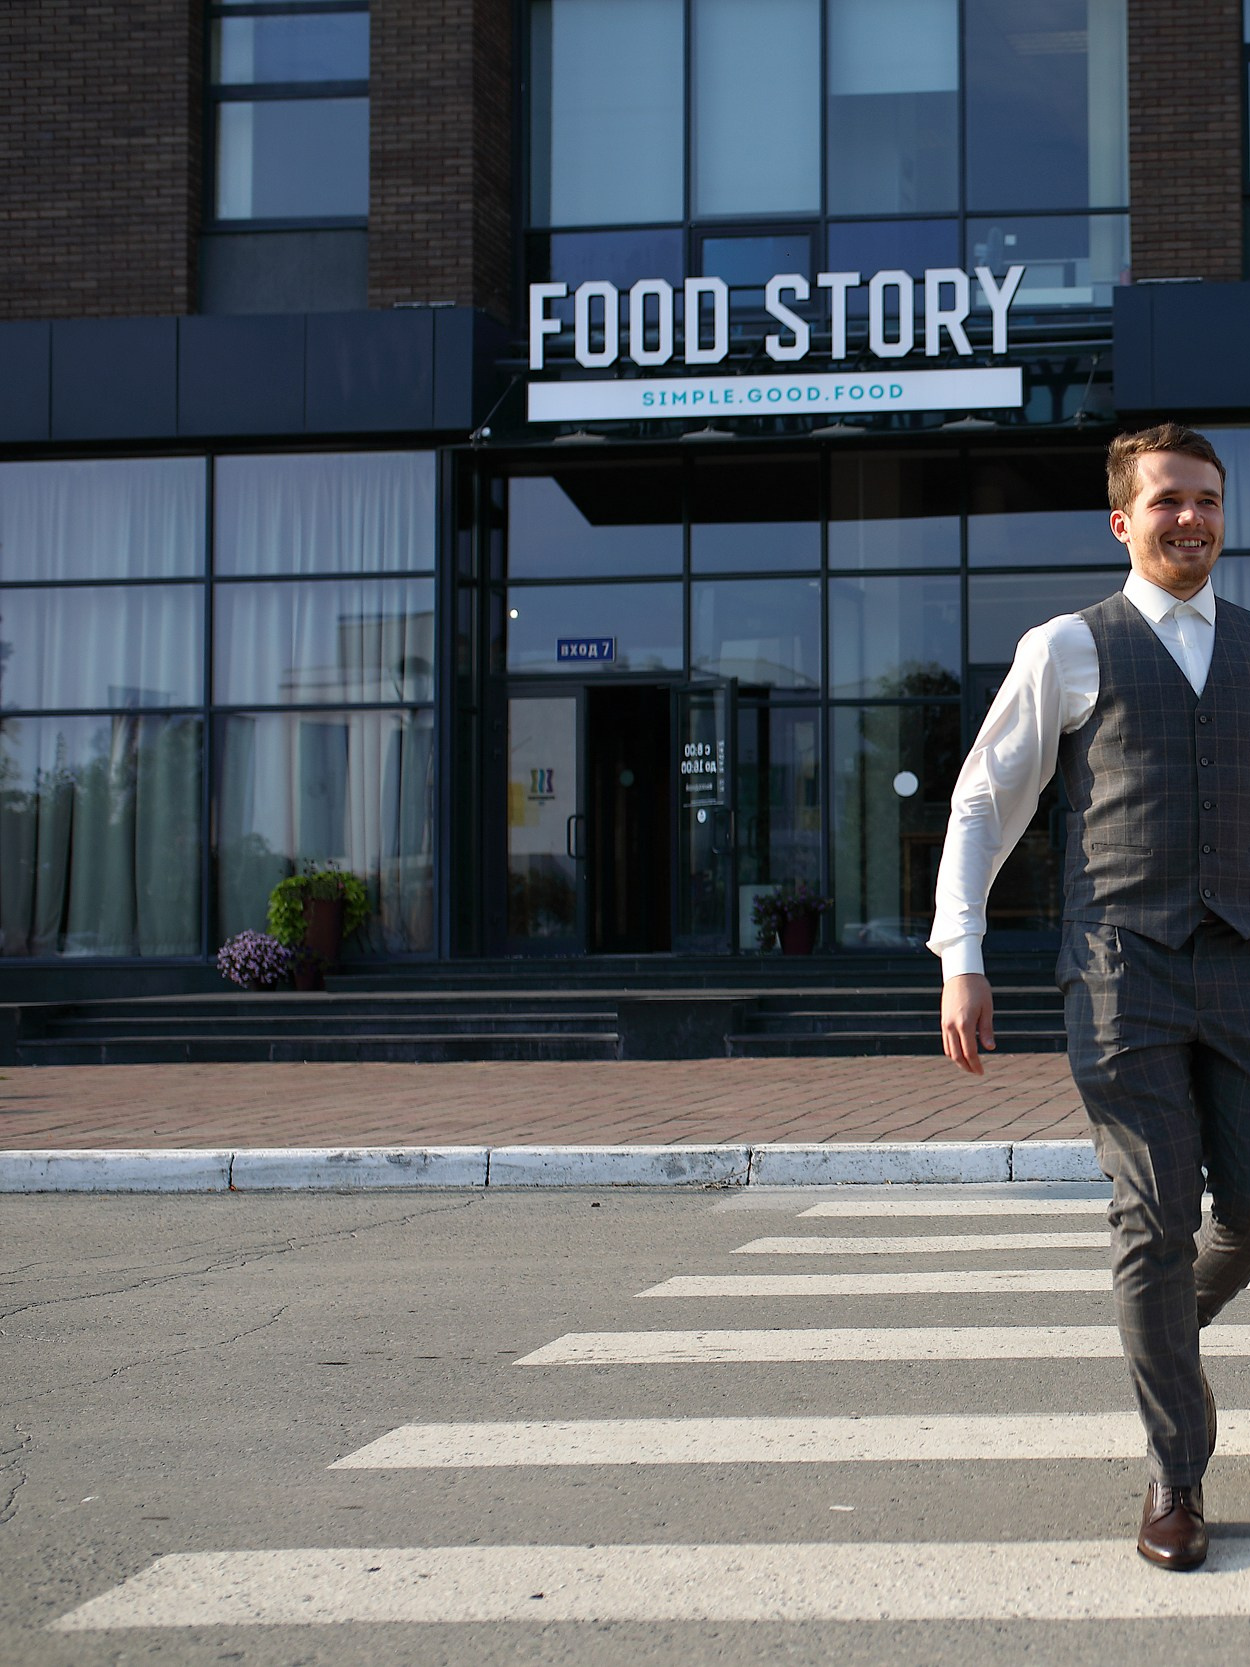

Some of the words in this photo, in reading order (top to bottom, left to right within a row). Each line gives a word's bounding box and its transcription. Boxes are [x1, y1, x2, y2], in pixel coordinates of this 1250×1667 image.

[529, 276, 729, 370] FOOD
[765, 265, 1027, 361] STORY
[642, 384, 904, 406] SIMPLE.GOOD.FOOD
[602, 641, 610, 657] 7
